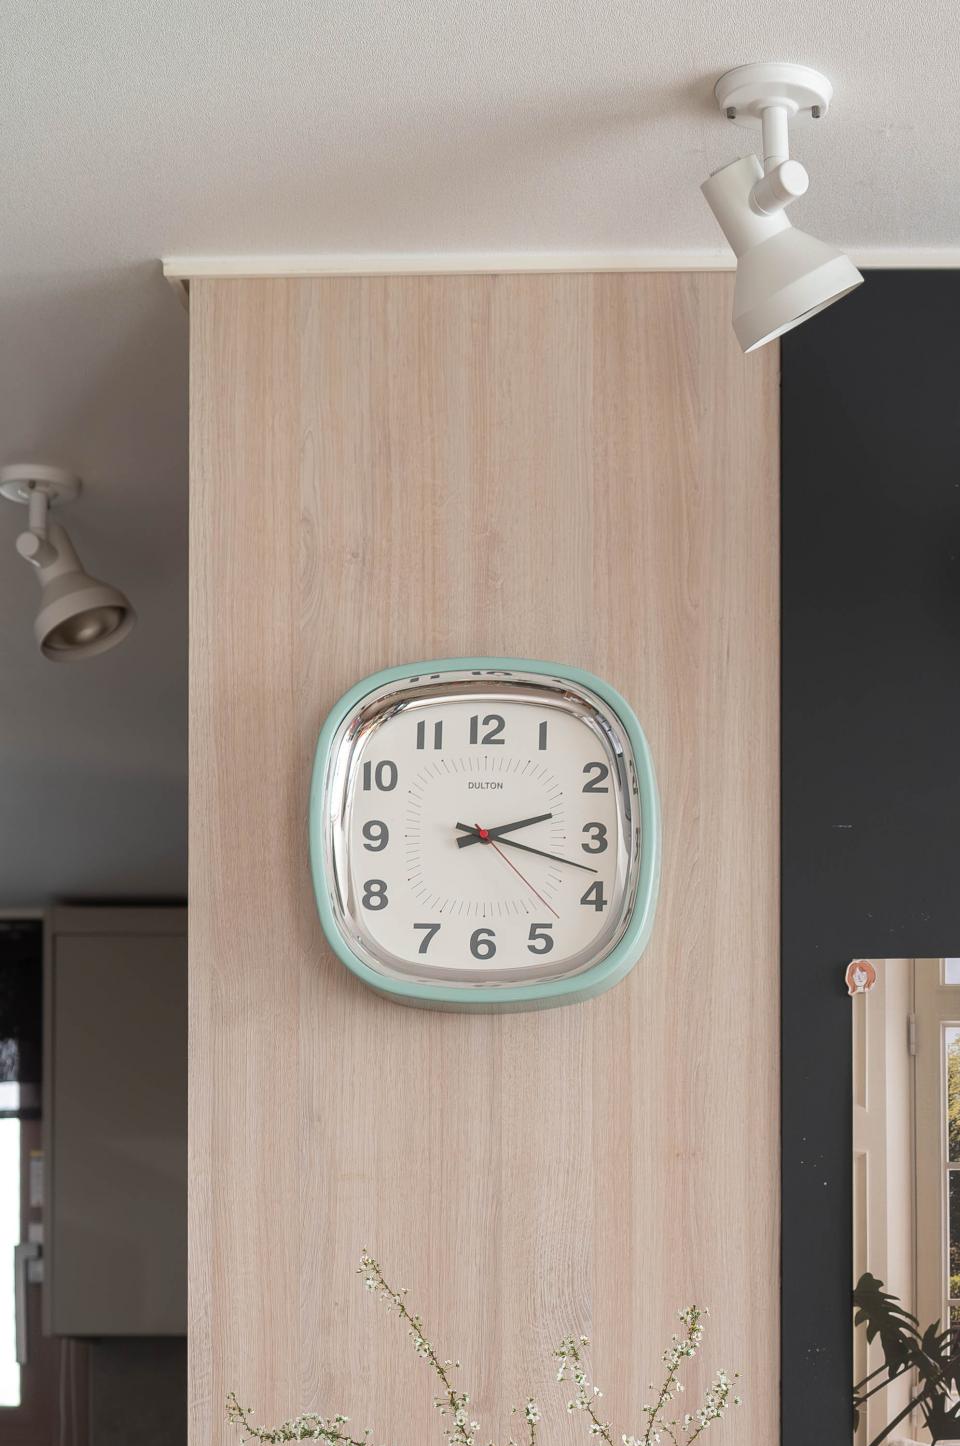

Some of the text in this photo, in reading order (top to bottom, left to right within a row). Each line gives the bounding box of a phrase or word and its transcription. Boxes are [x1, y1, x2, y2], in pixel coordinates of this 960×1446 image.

[416, 720, 443, 749] 11
[469, 715, 505, 744] 12
[538, 721, 547, 750] 1
[362, 760, 398, 791] 10
[467, 781, 504, 790] DULTON
[582, 762, 609, 793] 2
[362, 820, 389, 852] 9
[581, 822, 608, 854] 3
[362, 879, 388, 910] 8
[580, 881, 607, 912] 4
[413, 923, 441, 953] 7
[470, 929, 496, 960] 6
[527, 923, 554, 954] 5
